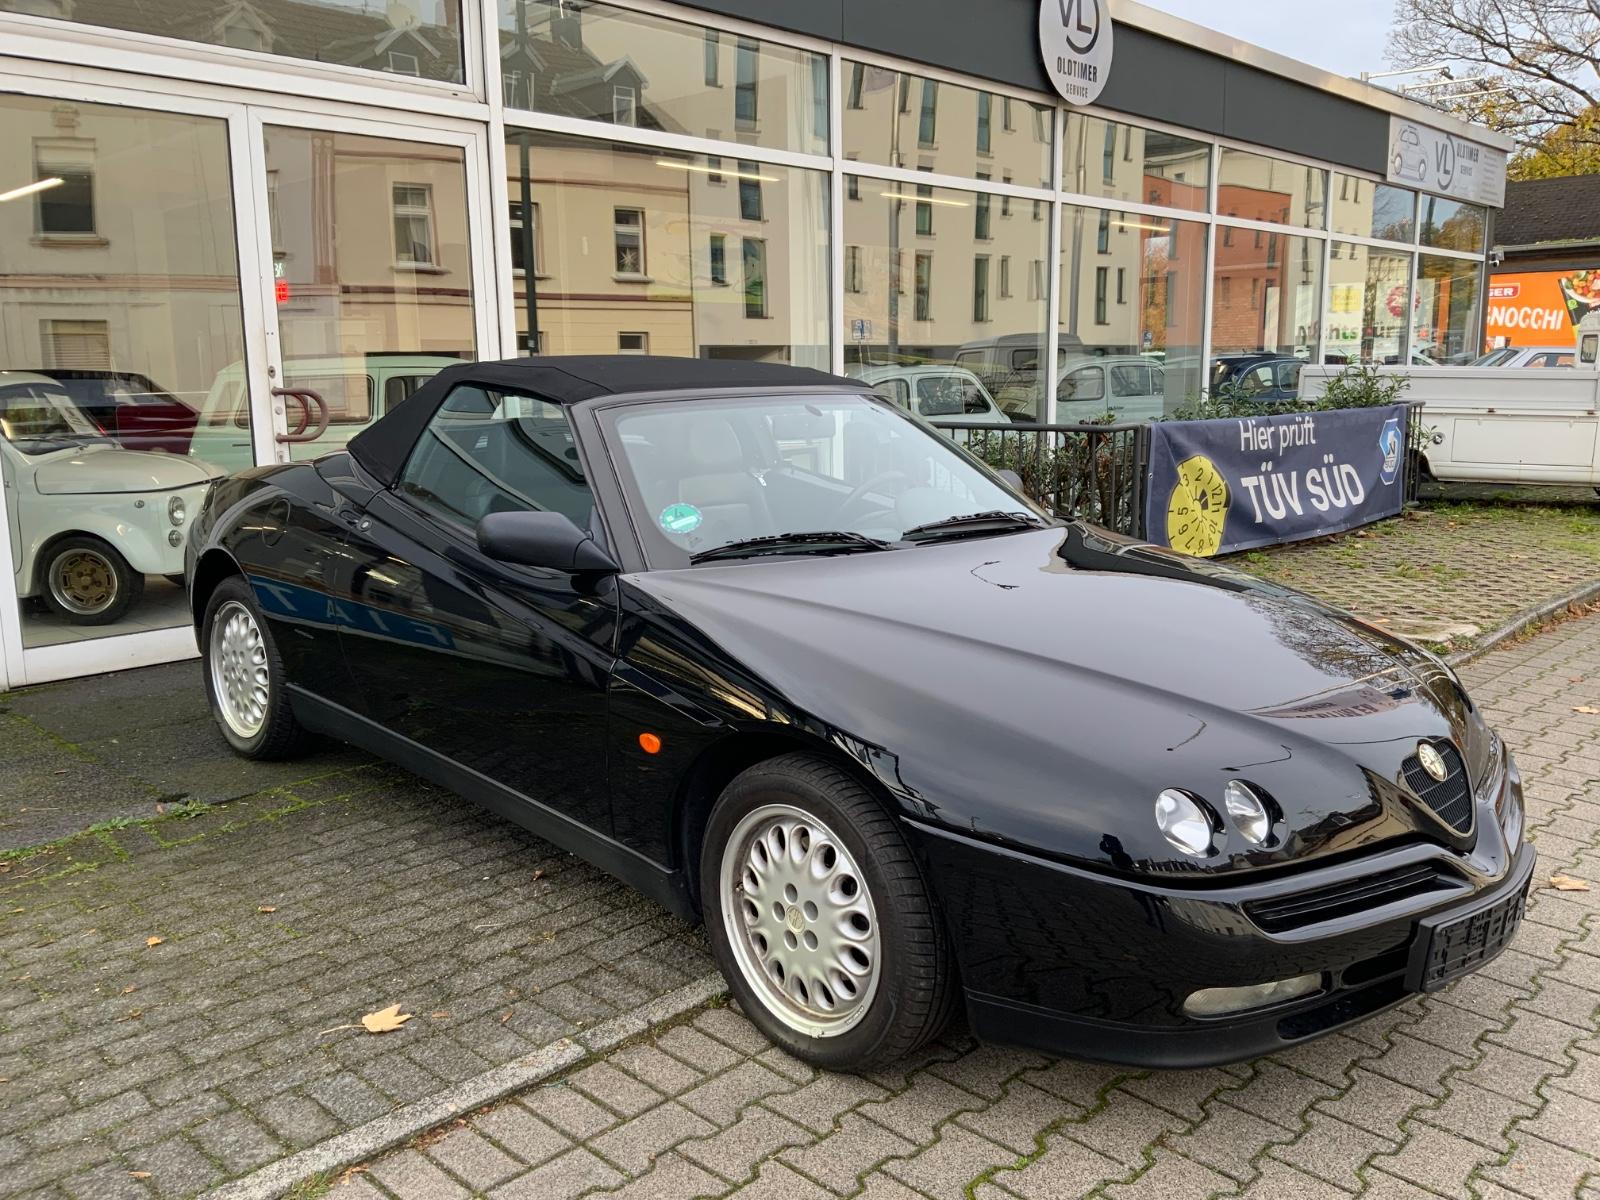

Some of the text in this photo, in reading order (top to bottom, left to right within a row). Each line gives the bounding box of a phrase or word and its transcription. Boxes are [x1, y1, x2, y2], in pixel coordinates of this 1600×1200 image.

[1056, 56, 1098, 83] OLDTIMER
[1065, 83, 1088, 98] SERVICE
[1240, 416, 1316, 456] Hier prüft
[1194, 467, 1204, 482] 2
[1240, 453, 1365, 524] TÜV SÜD
[1177, 506, 1189, 516] 5
